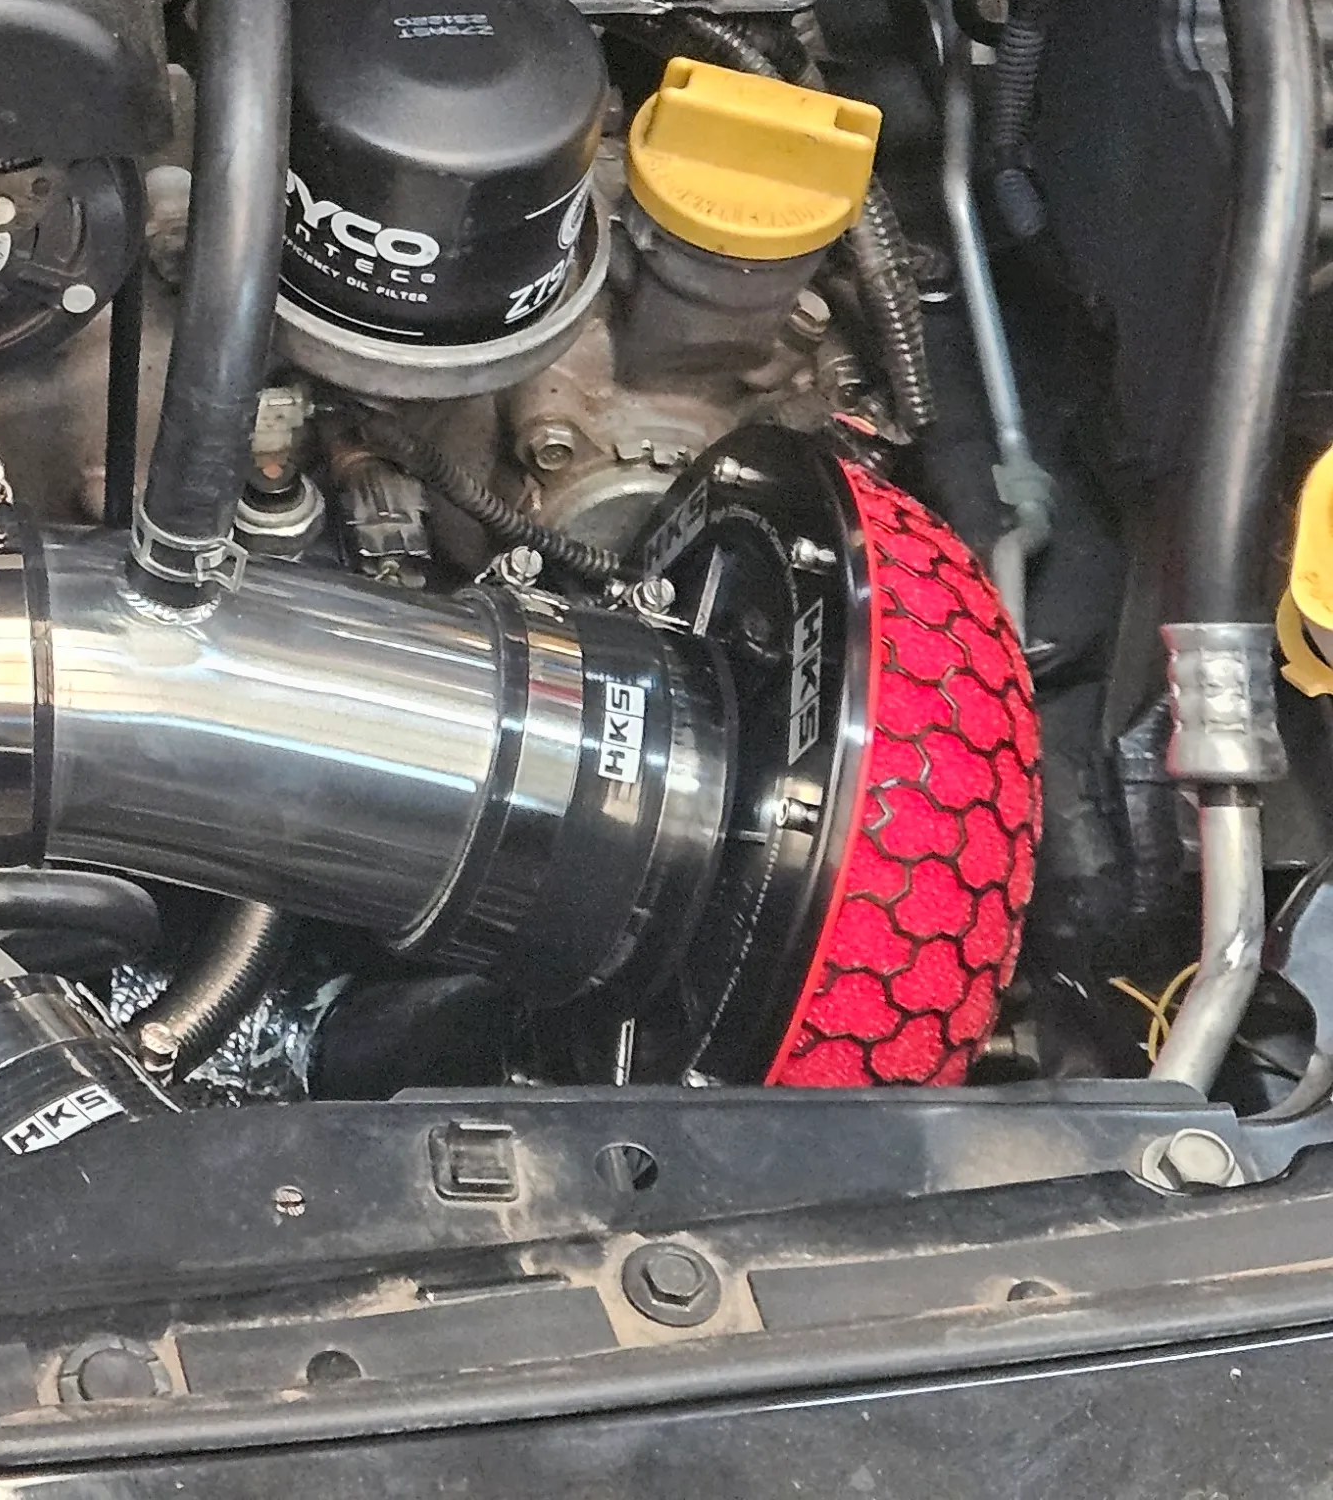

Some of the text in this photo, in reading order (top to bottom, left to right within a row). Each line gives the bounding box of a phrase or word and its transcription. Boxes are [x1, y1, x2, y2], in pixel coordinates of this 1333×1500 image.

[286, 168, 441, 268] YCO
[346, 275, 370, 293] OIL
[375, 285, 429, 304] FILTER
[795, 603, 822, 753] HKS
[602, 685, 634, 778] HKS
[8, 1087, 112, 1152] HKS
